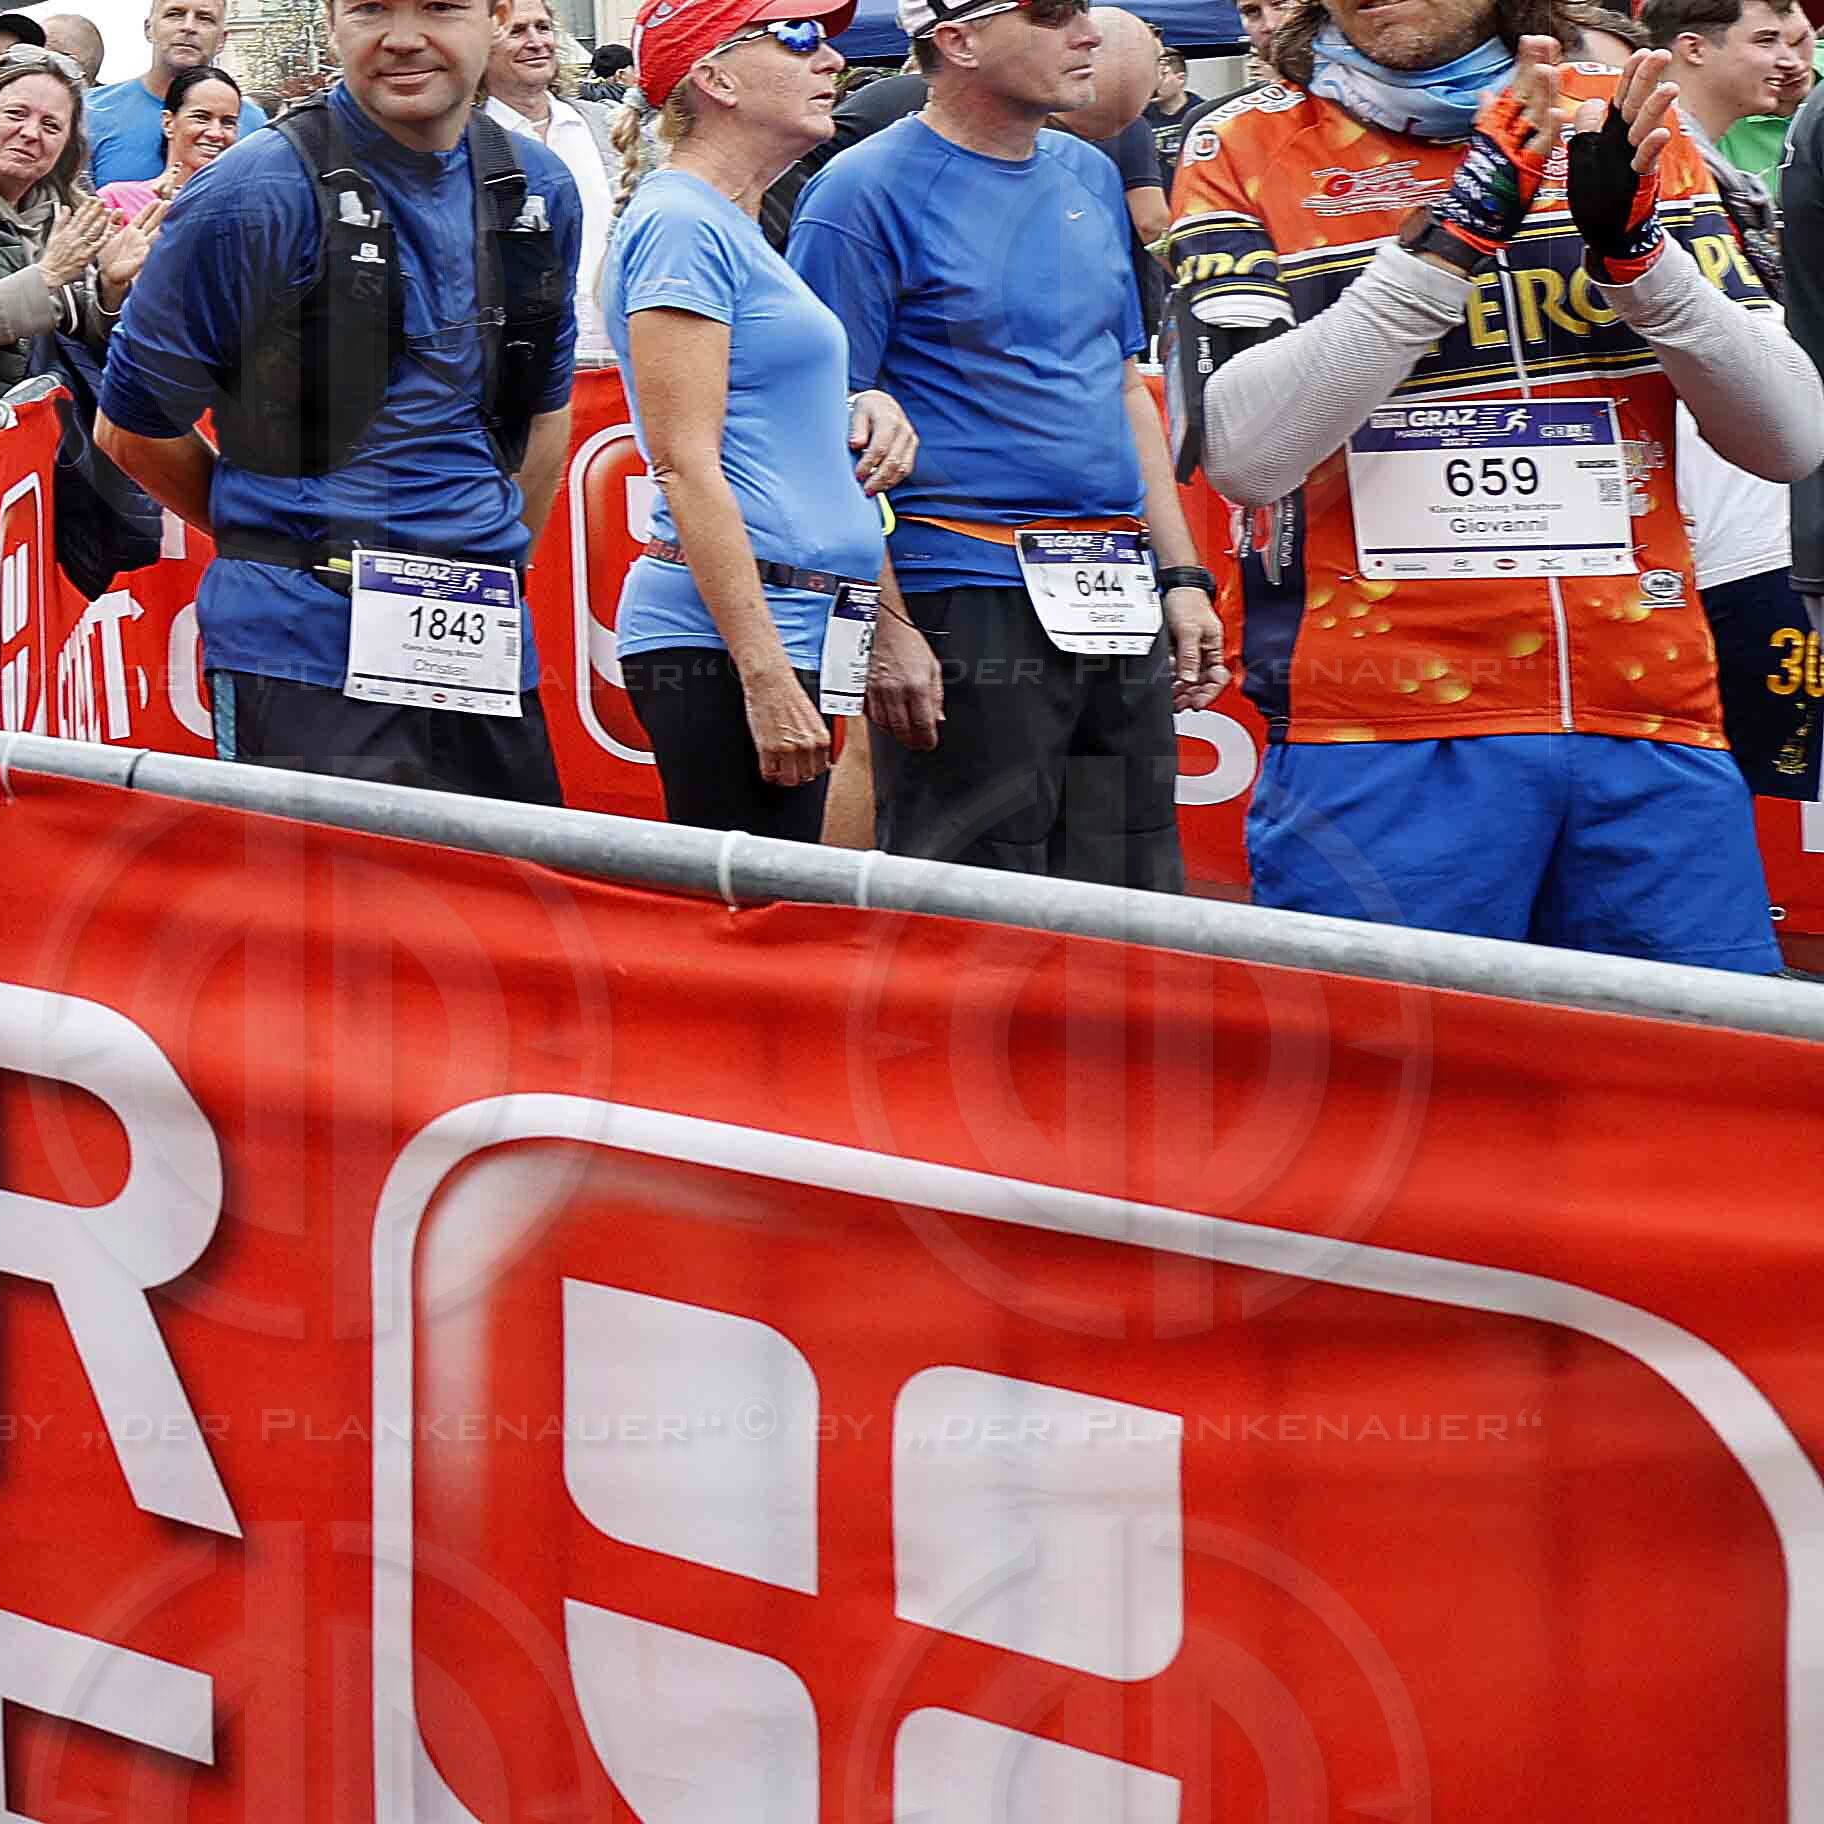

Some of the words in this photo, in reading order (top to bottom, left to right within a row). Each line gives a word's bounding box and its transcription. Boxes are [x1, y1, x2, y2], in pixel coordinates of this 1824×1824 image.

[1409, 408, 1478, 427] GRAZ
[1445, 456, 1540, 497] 659
[1449, 515, 1550, 535] Giovanni
[404, 561, 451, 580] GRAZ
[1074, 570, 1126, 597] 644
[409, 605, 486, 645] 1843
